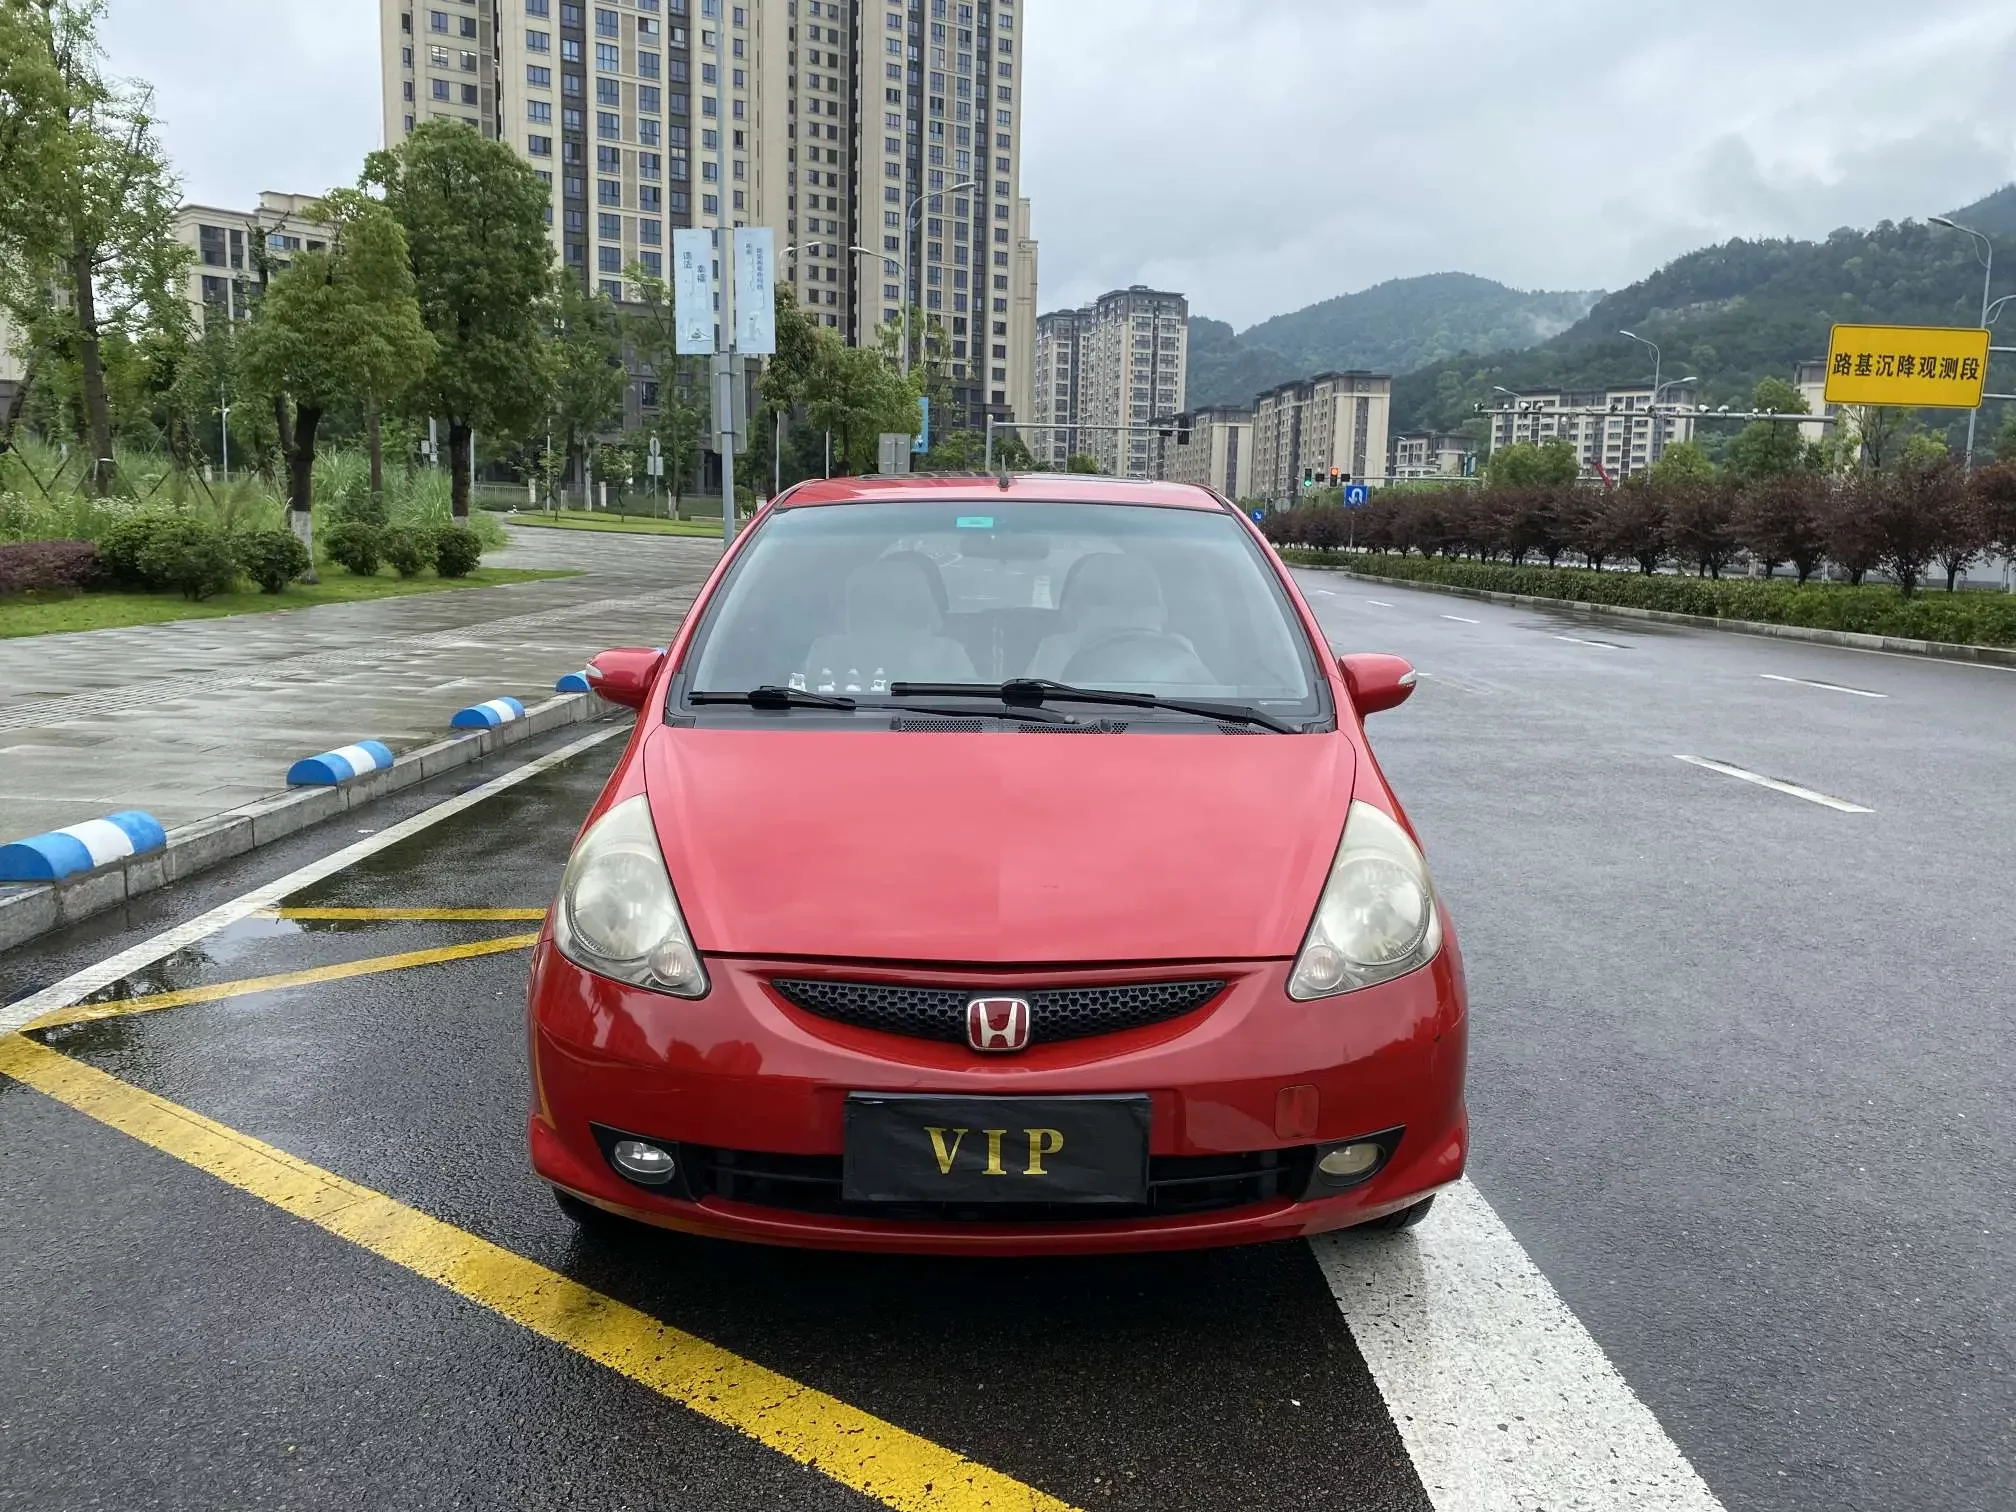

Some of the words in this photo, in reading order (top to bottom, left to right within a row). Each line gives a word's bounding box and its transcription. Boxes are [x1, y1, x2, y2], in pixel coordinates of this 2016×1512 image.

[1832, 352, 1980, 381] 路基沉降观测段
[923, 1126, 1064, 1175] VIP
